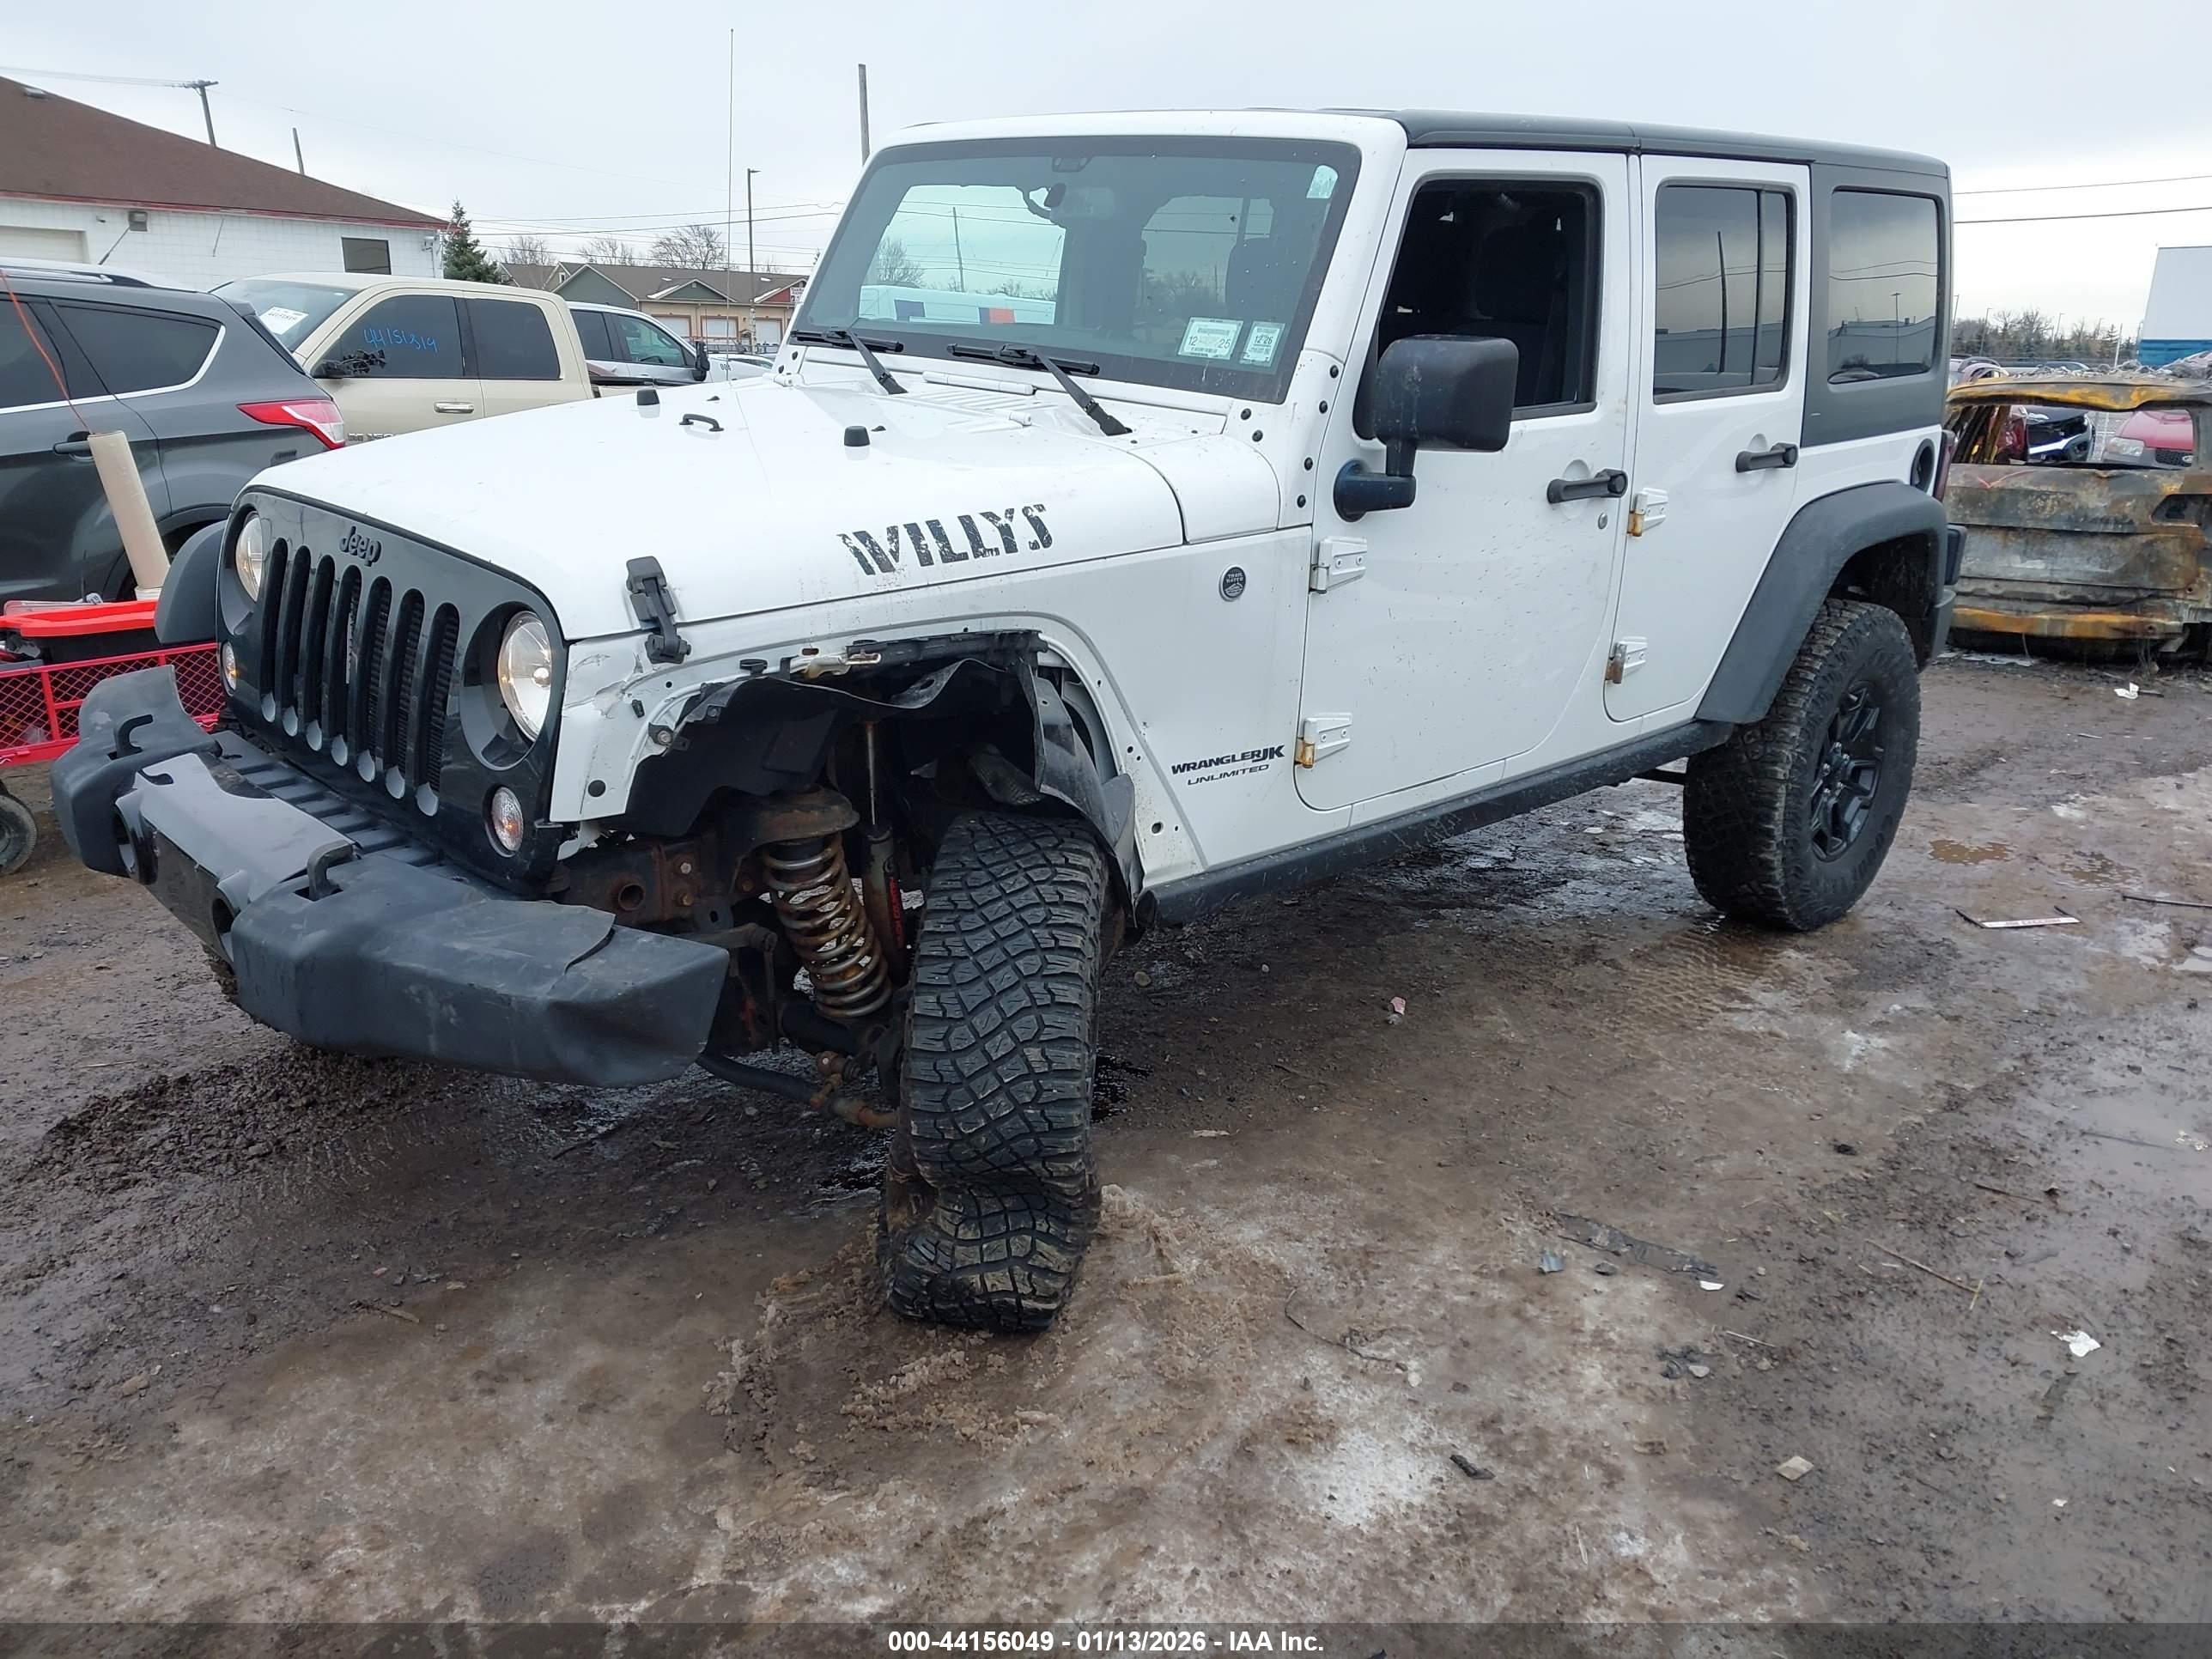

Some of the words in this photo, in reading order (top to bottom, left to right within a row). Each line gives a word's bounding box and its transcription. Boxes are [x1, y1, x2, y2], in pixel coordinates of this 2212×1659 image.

[339, 526, 382, 567] Jeep
[836, 503, 1053, 575] WILLYS
[1188, 764, 1270, 785] UNLIMITED
